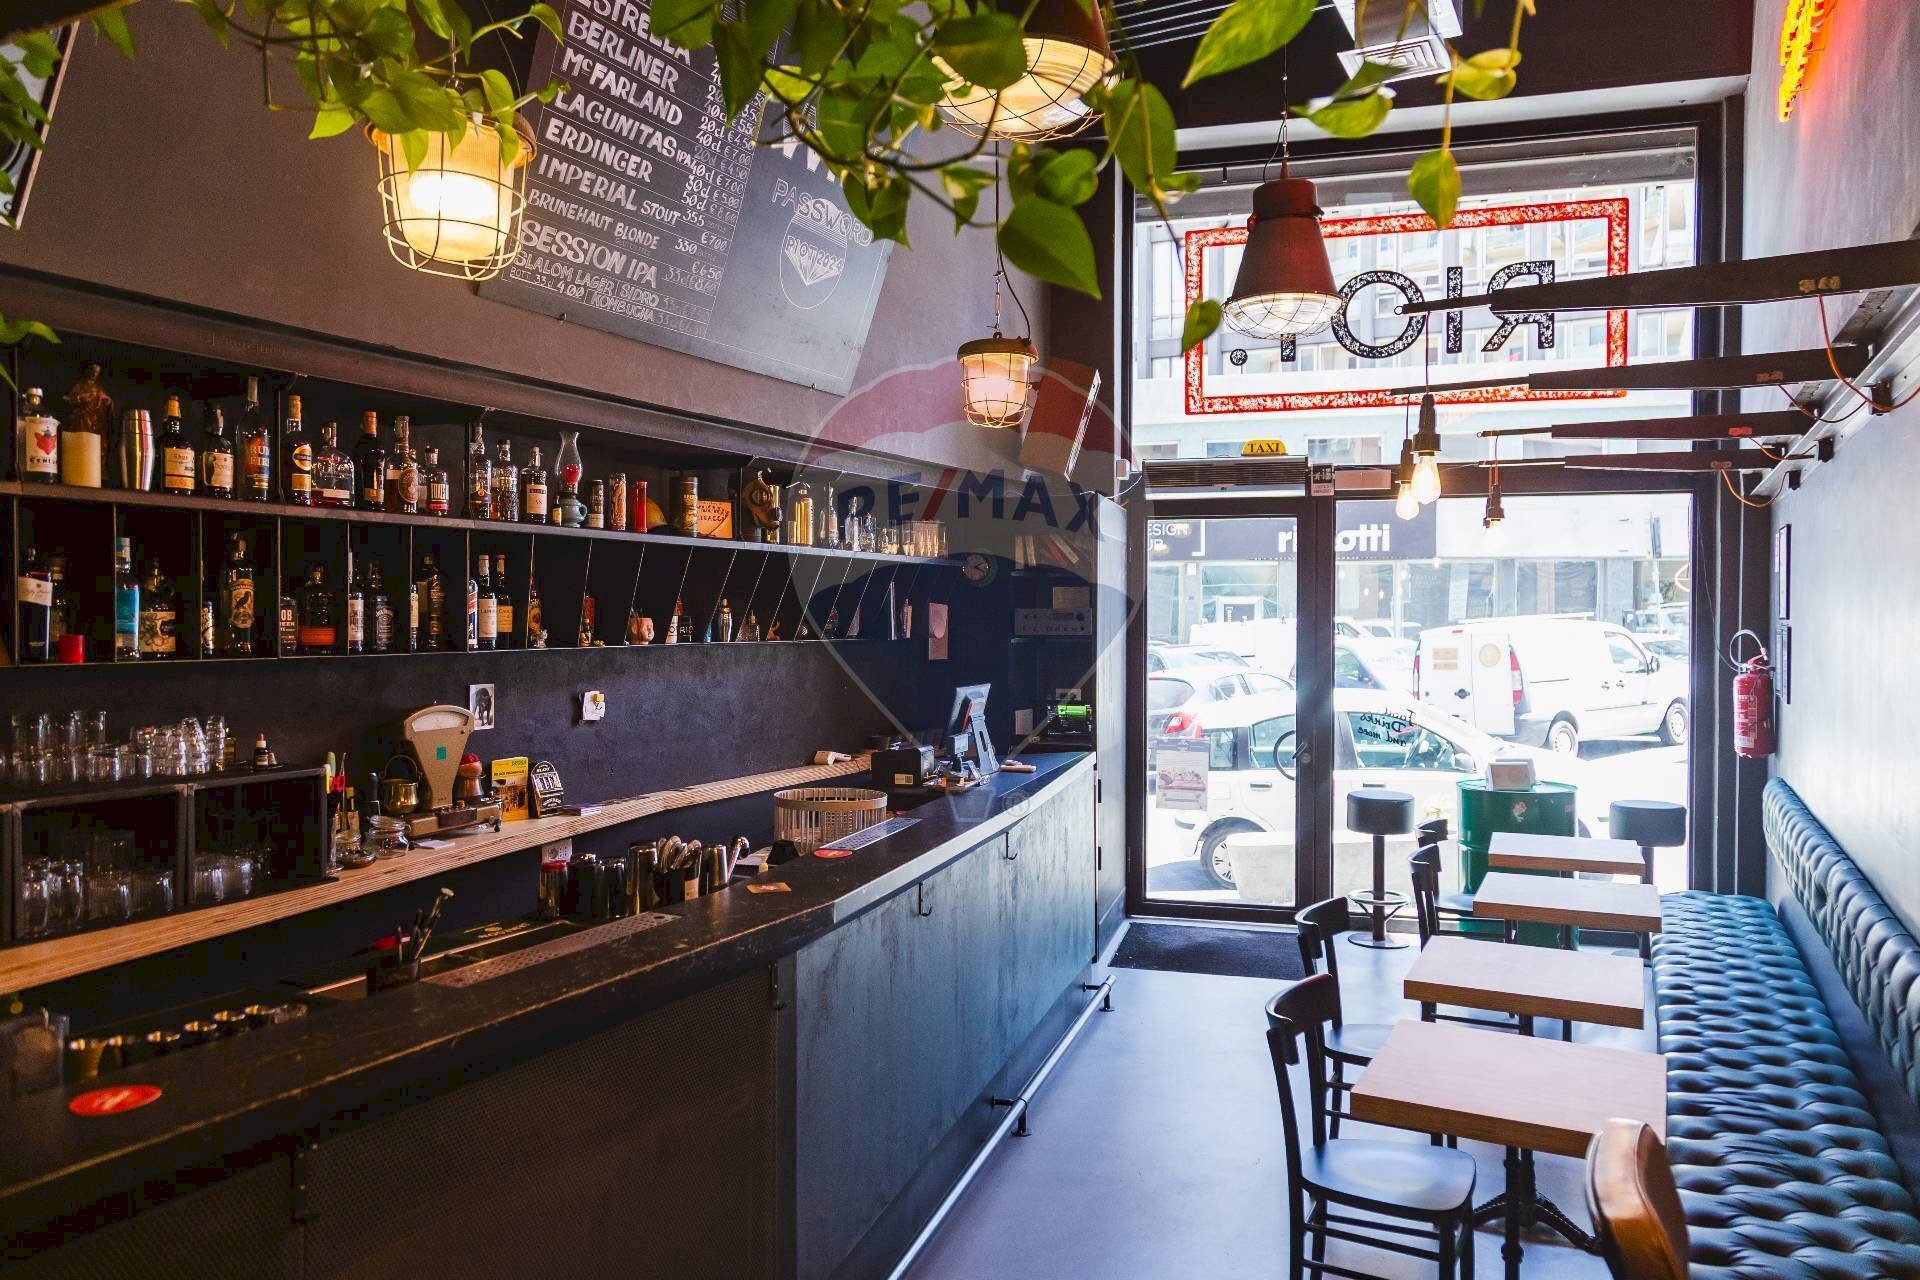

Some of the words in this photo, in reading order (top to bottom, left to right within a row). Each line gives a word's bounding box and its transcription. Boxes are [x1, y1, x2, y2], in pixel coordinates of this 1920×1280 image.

[567, 10, 679, 93] BERLINER
[561, 47, 683, 126] McFARLAND
[545, 117, 653, 183] ERDINGER
[554, 87, 677, 158] LAGUNITAS
[695, 130, 721, 153] 40cl
[527, 188, 615, 232] BRUNEHAUT
[614, 222, 660, 250] BLONDE
[538, 153, 637, 211] IMPERIAL
[641, 199, 682, 226] STOUT
[681, 189, 707, 212] 50cl
[513, 250, 574, 282] SLALOM
[574, 269, 615, 297] LAGER
[520, 219, 627, 275] SESSION
[626, 258, 658, 289] IPA
[590, 290, 655, 323] KOMBUCHA
[619, 283, 660, 308] SIDRO
[1247, 442, 1280, 453] TAXI
